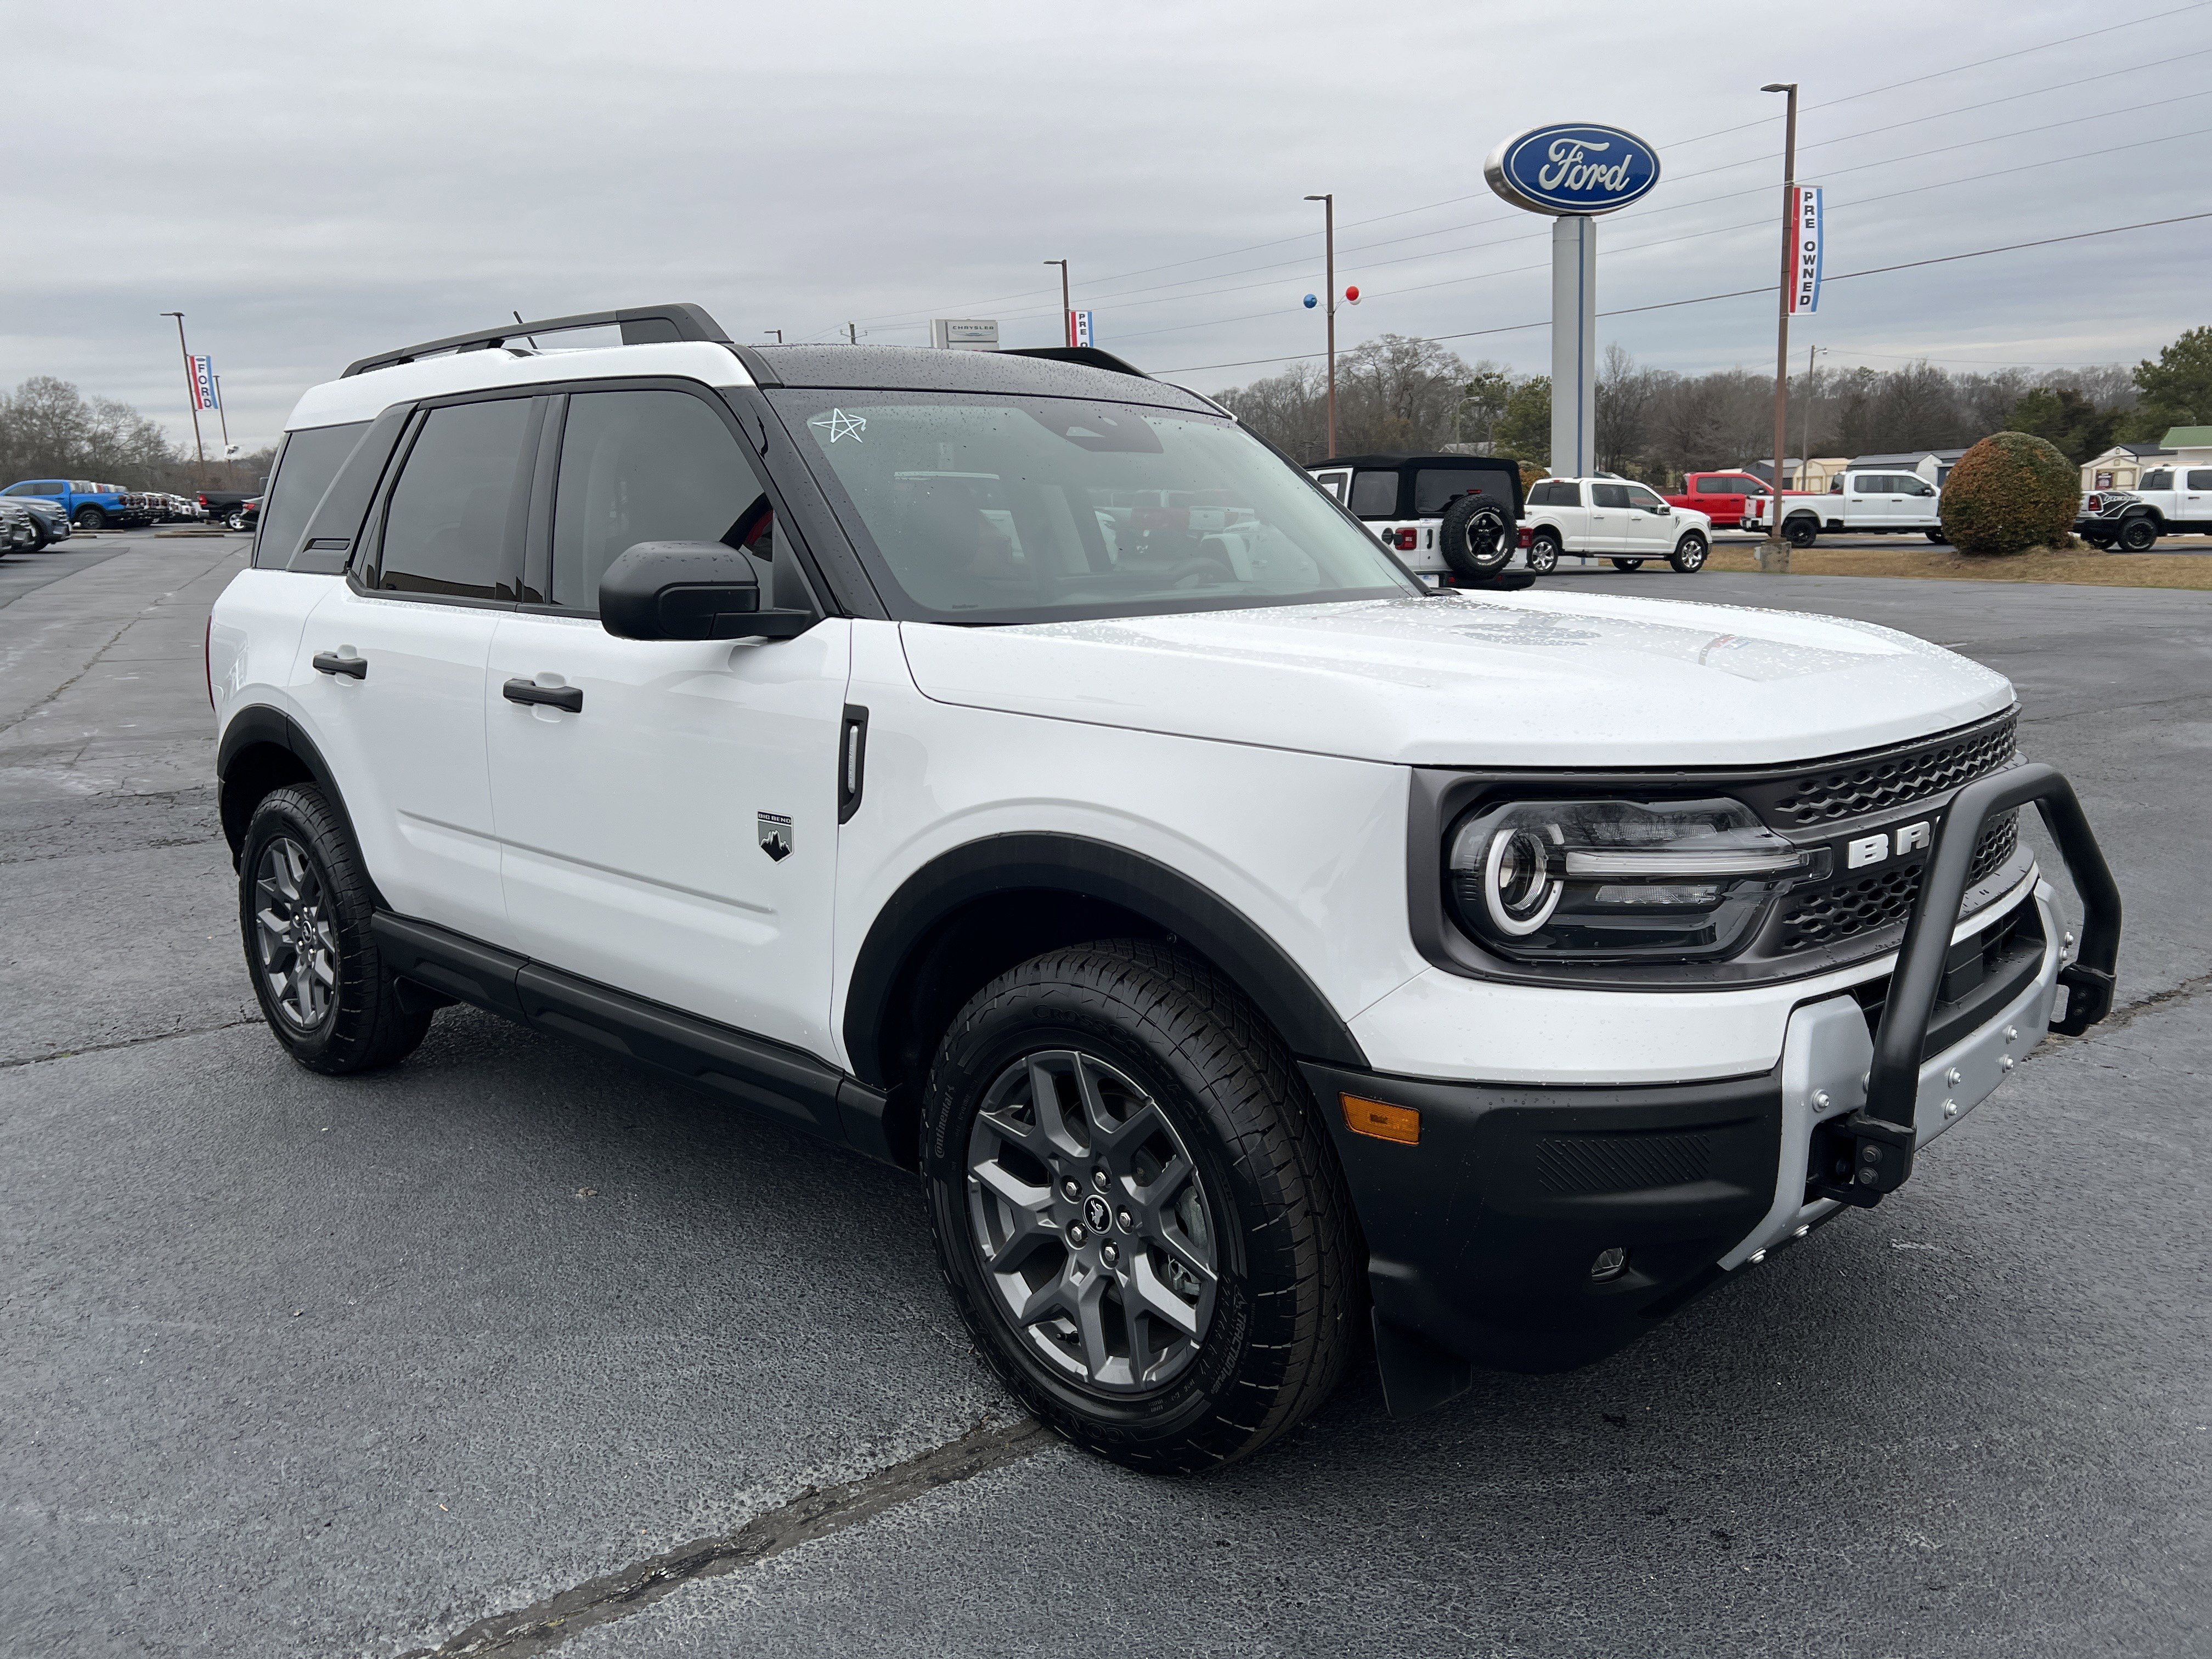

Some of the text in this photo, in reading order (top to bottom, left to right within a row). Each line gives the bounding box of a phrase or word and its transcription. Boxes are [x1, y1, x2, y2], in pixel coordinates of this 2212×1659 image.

[1538, 138, 1633, 191] Ford
[1800, 191, 1816, 306] PRE OWNED
[1079, 313, 1087, 335] PRE
[198, 364, 212, 408] FORD
[1848, 816, 1940, 869] BR
